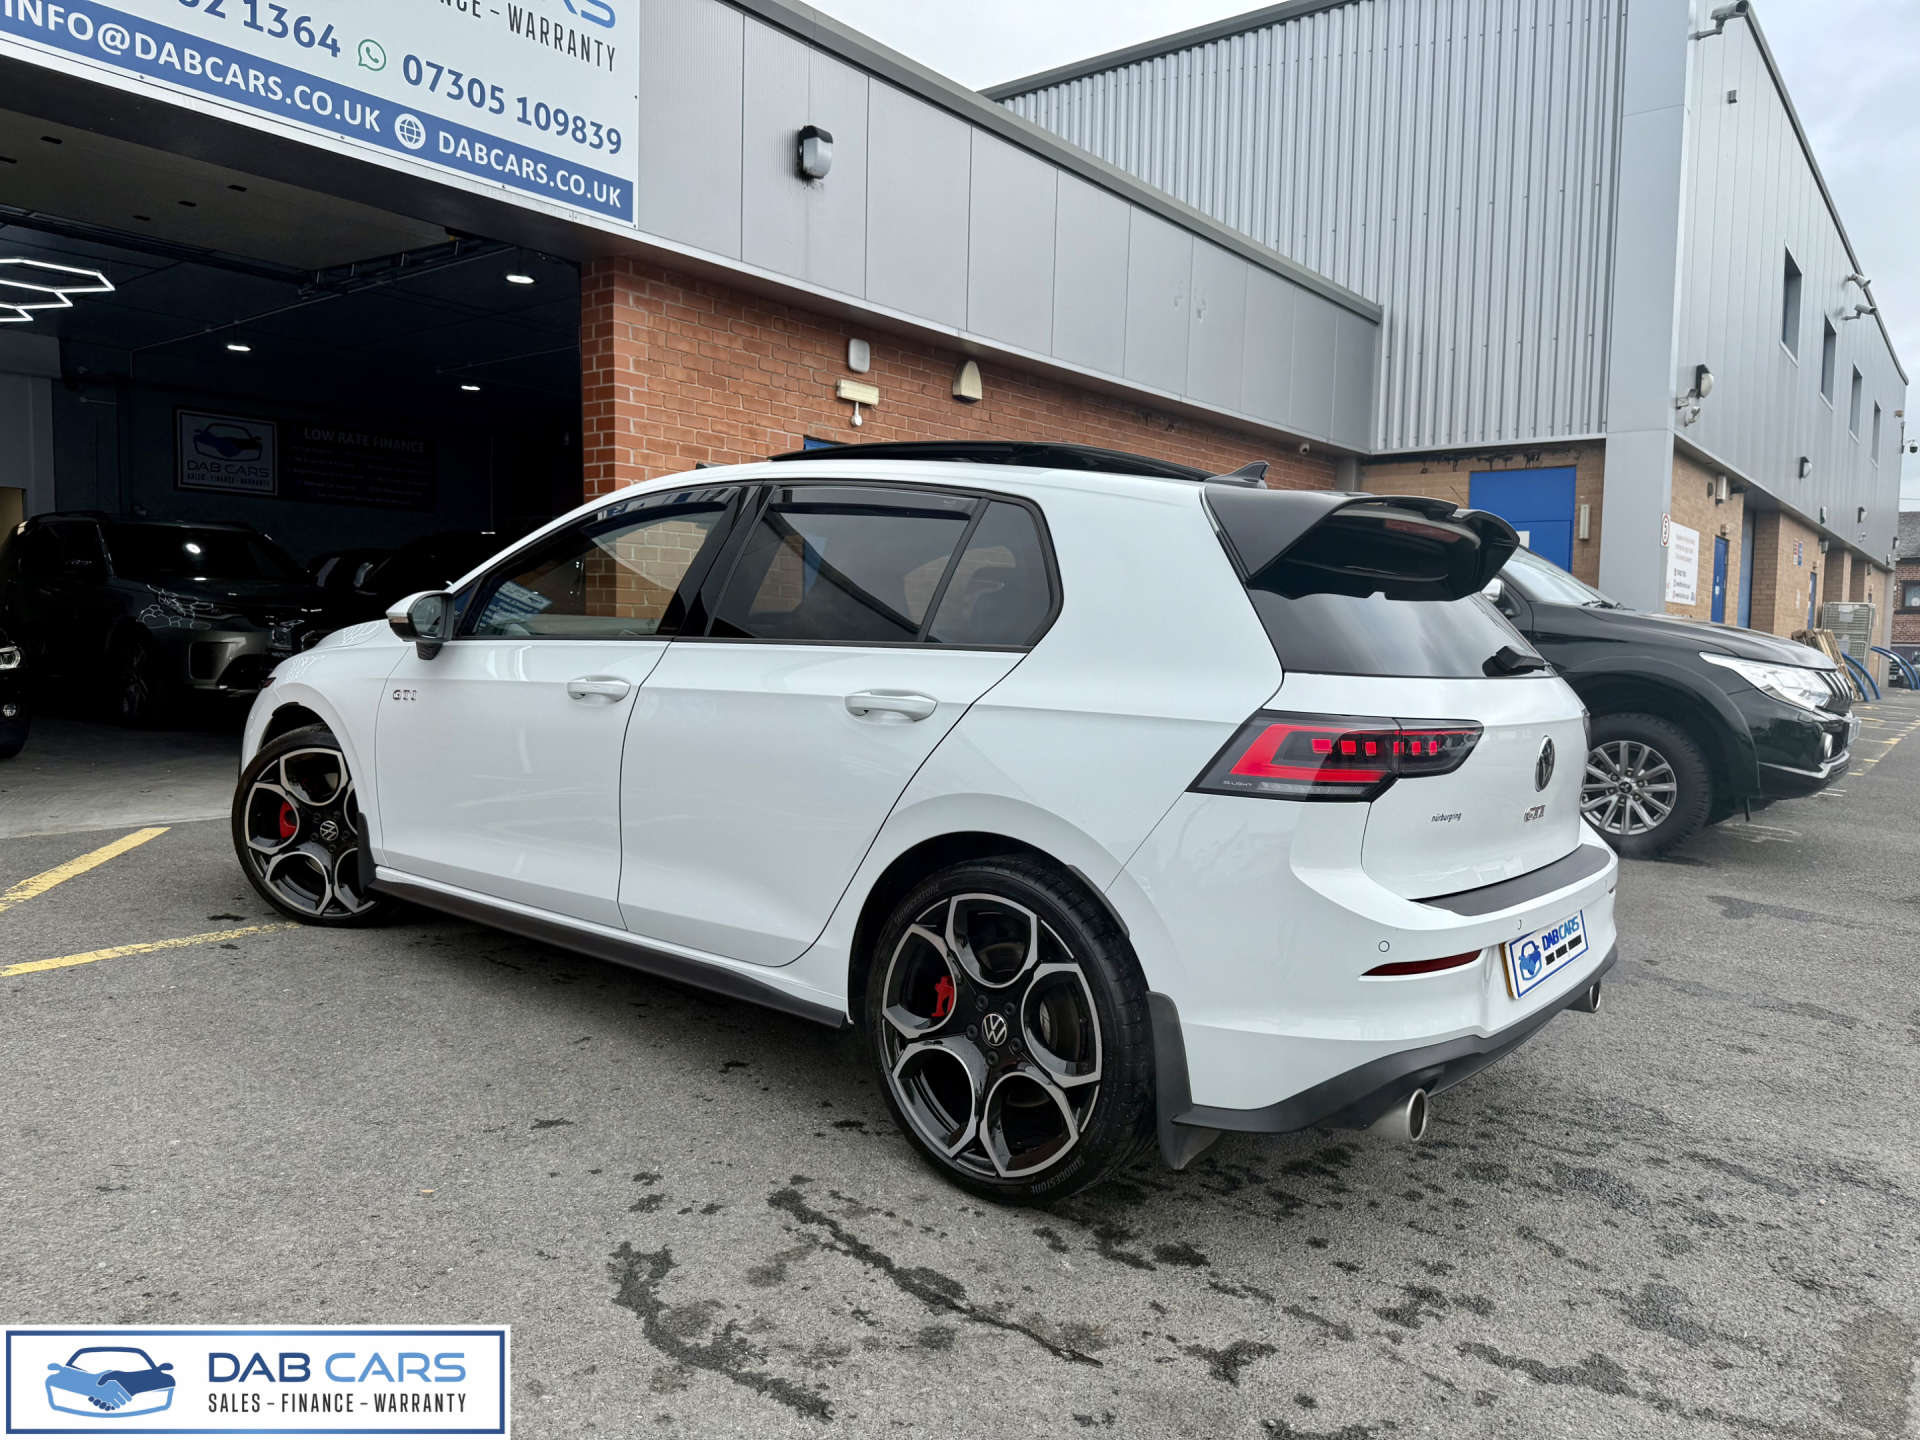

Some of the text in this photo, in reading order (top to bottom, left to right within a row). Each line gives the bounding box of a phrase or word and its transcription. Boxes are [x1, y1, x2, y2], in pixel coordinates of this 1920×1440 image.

[242, 0, 341, 58] 1364
[507, 3, 616, 72] WARRANTY
[4, 0, 381, 133] INFO@DABCARS.CO.UK
[402, 54, 622, 154] 07305 109839
[438, 130, 622, 208] DABCARS.CO.UK
[304, 427, 424, 453] LOW RATE FINANCE
[186, 459, 270, 478] DAB CARS
[392, 689, 418, 701] GTI
[1523, 804, 1546, 822] GTI
[1541, 928, 1560, 951] DAB
[1559, 916, 1580, 940] CARS
